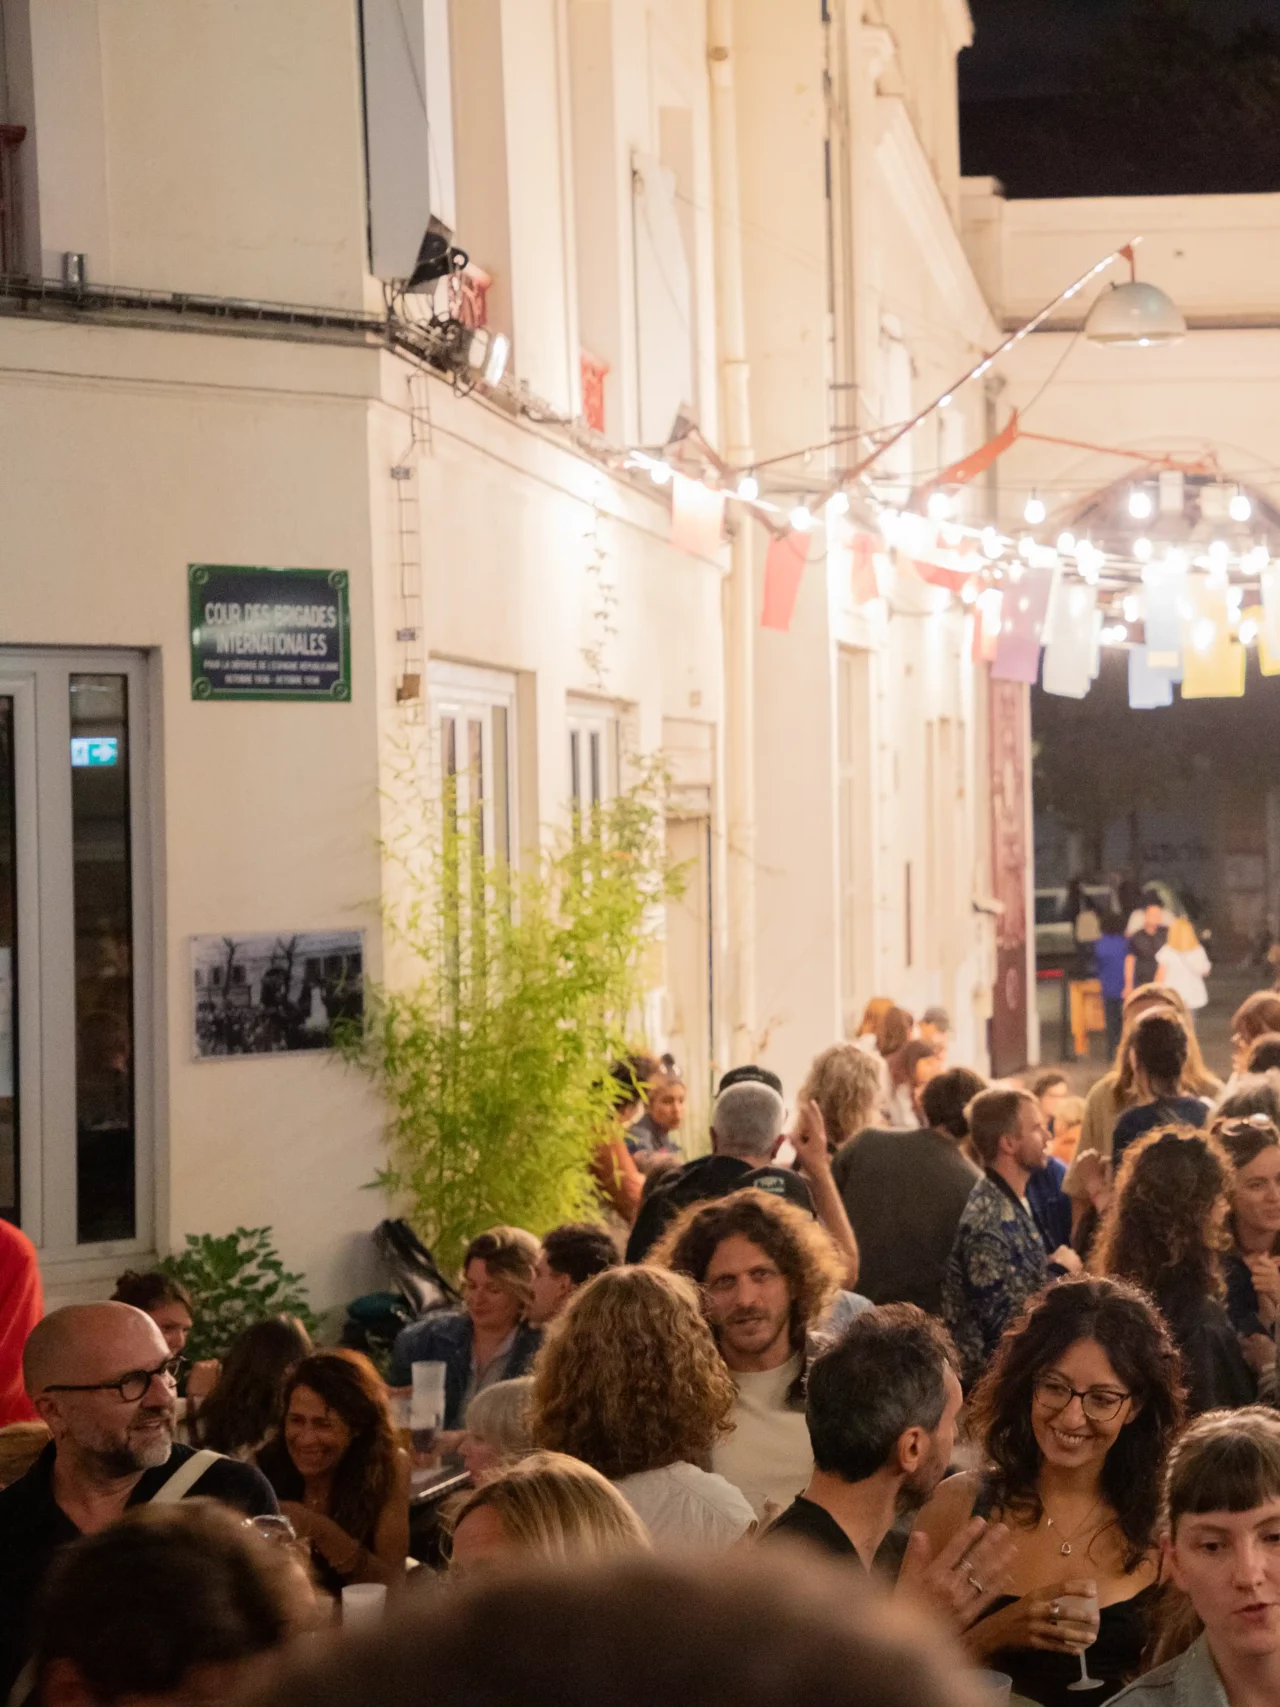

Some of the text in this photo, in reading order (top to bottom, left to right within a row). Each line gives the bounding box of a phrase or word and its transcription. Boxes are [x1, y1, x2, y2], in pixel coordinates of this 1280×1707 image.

[205, 602, 337, 628] COUR DES BRIGADES
[216, 632, 328, 656] INTERNATIONALES
